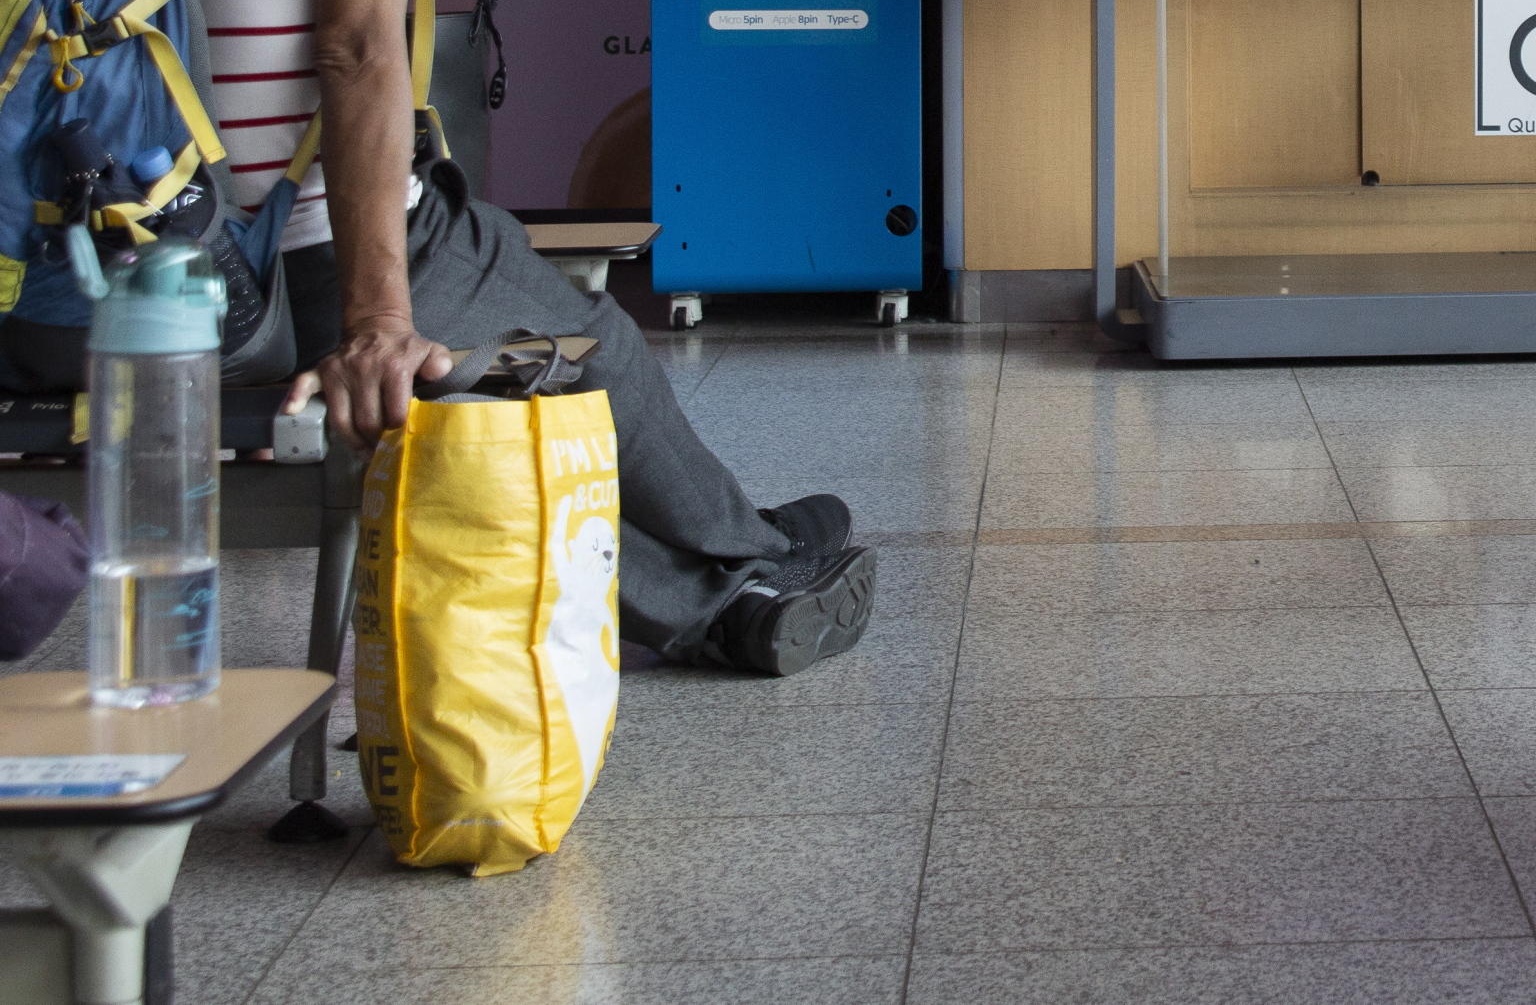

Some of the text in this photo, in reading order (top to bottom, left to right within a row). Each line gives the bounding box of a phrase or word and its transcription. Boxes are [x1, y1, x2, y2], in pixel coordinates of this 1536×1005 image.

[743, 15, 764, 26] 5pin
[798, 15, 819, 26] 8pin
[827, 15, 860, 25] Type-C
